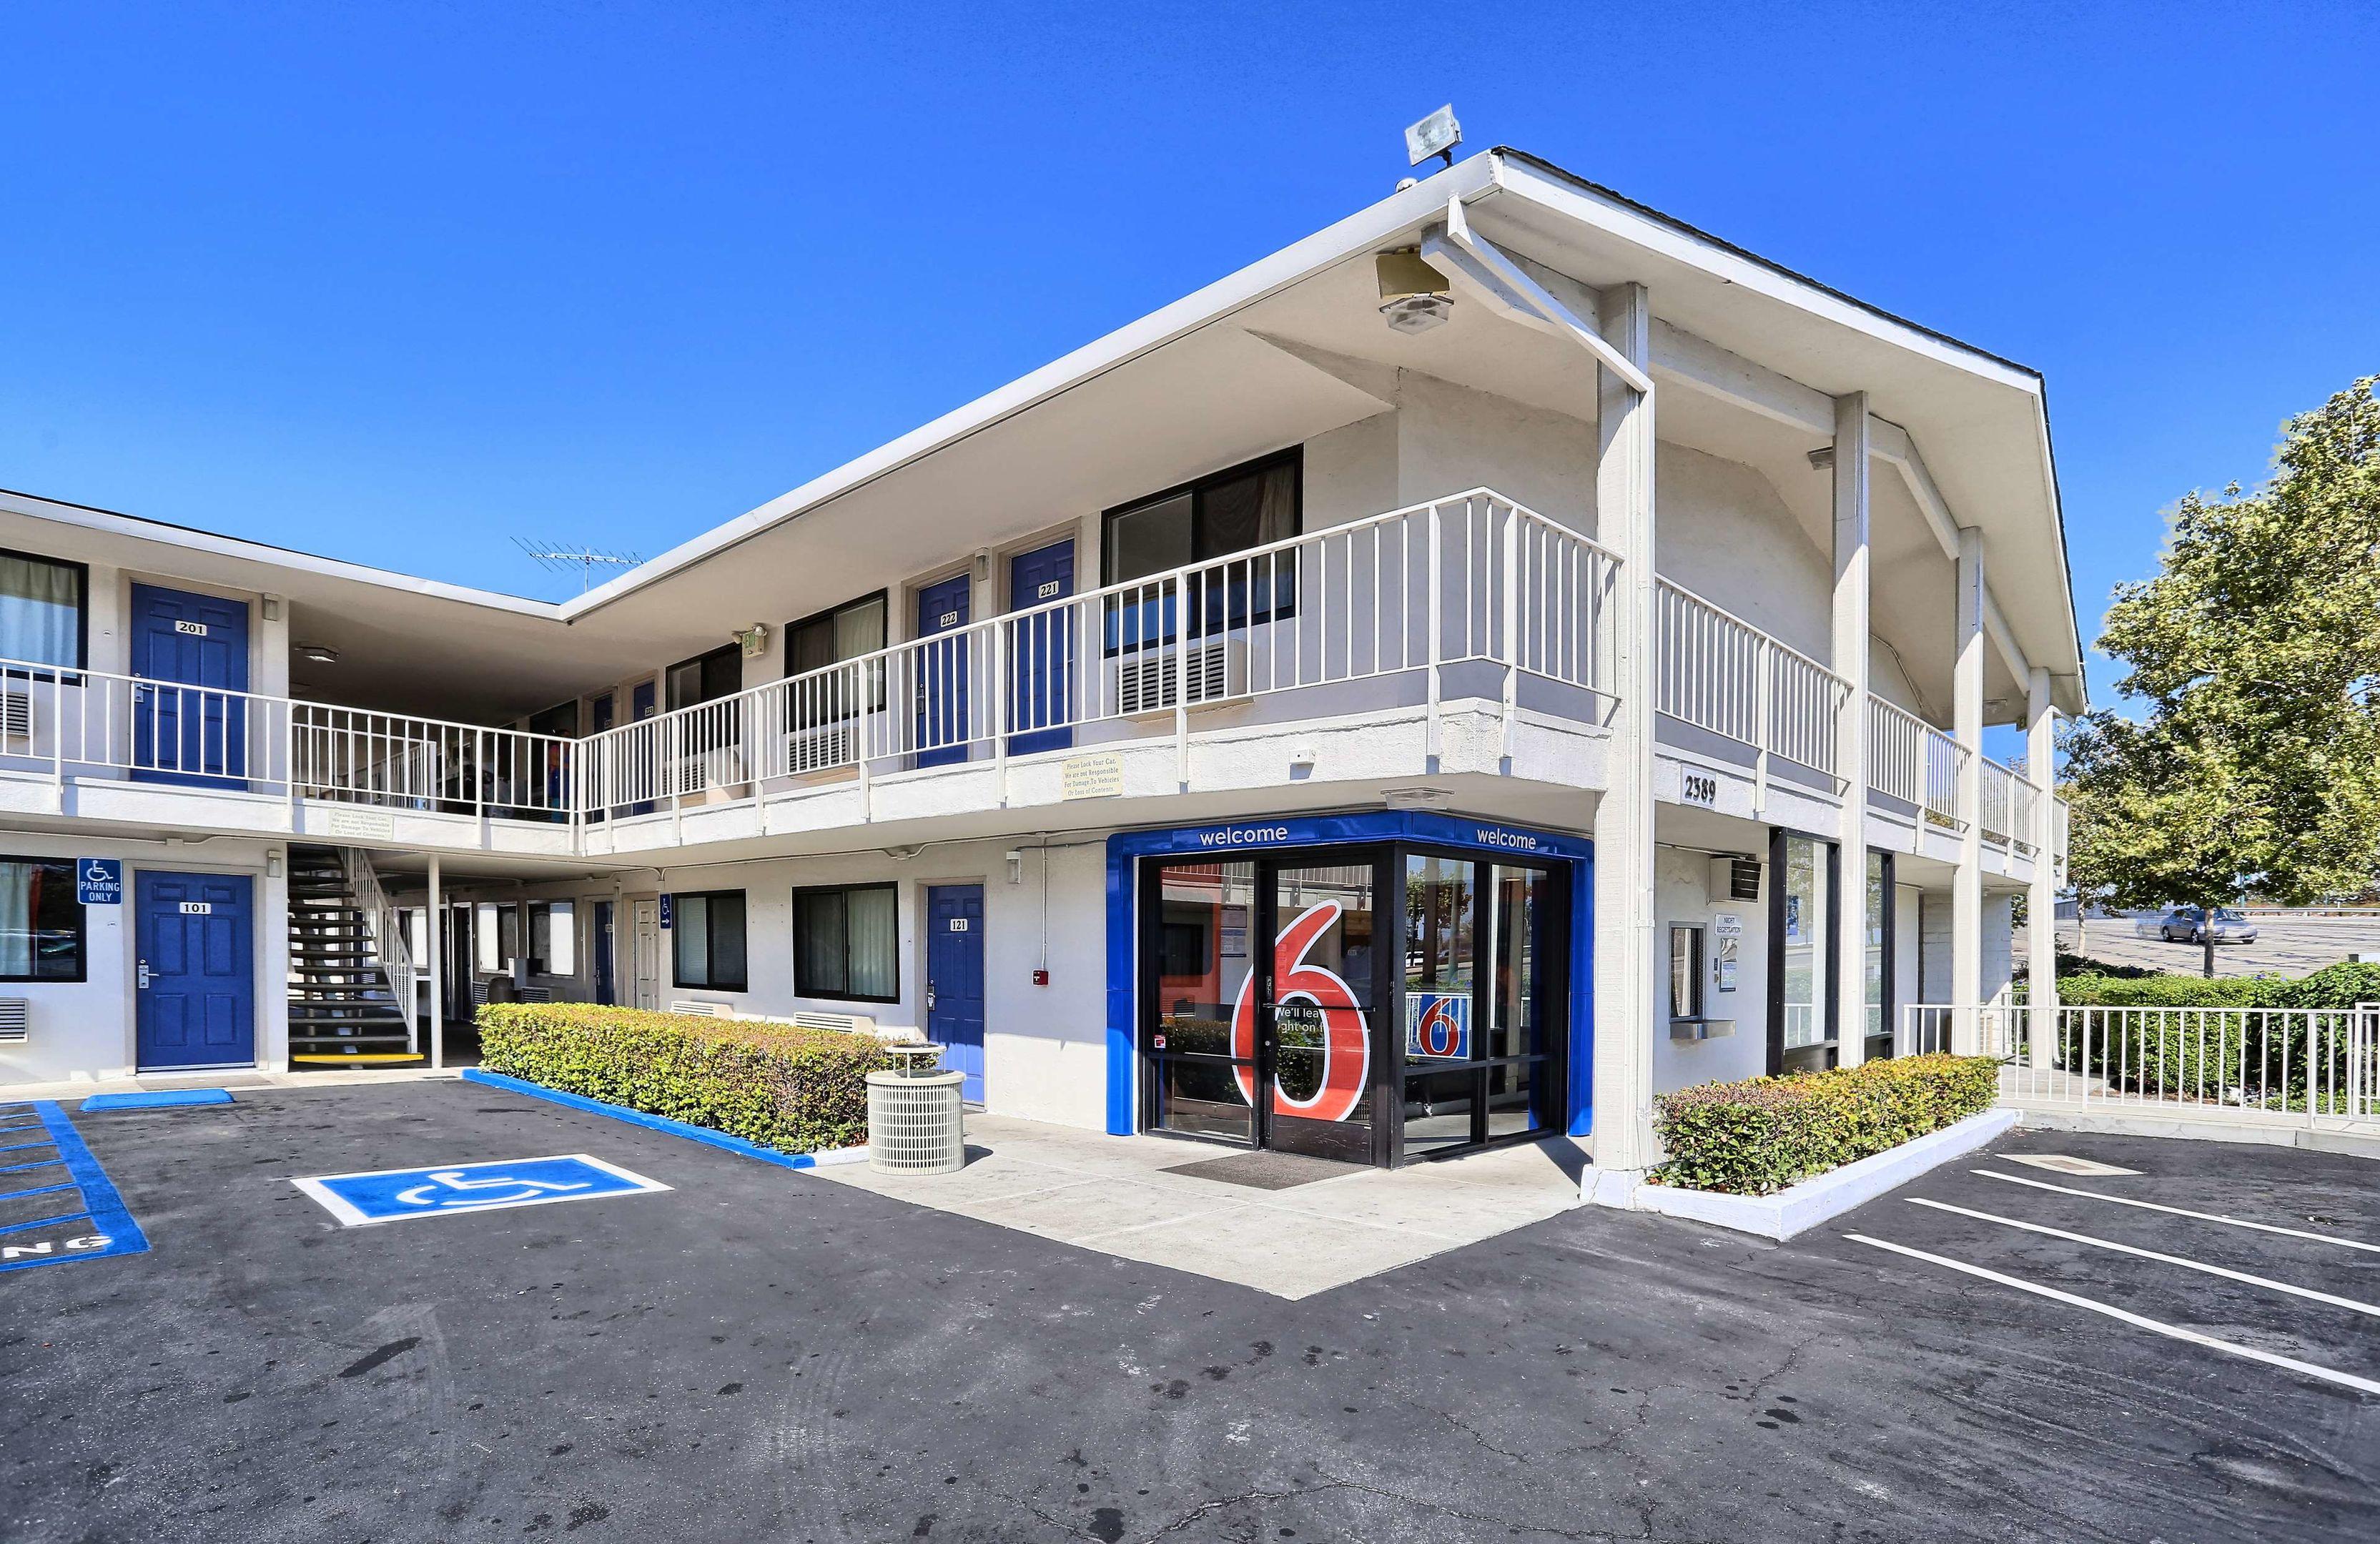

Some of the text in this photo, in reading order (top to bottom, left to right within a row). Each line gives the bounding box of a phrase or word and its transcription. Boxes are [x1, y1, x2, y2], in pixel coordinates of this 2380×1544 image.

[1040, 583, 1057, 597] 221
[942, 613, 957, 625] 222
[179, 623, 203, 634] 201
[1088, 767, 1118, 776] Responsible
[1684, 775, 1716, 805] 2389
[1200, 826, 1288, 846] welcome
[1476, 828, 1536, 850] welcome
[80, 881, 120, 892] PARKING
[89, 892, 112, 901] ONLY
[184, 904, 206, 913] 101
[952, 920, 966, 930] 121
[1230, 899, 1371, 1122] 6
[1277, 1019, 1299, 1034] ight
[1302, 1024, 1315, 1032] on
[1418, 996, 1461, 1056] 6
